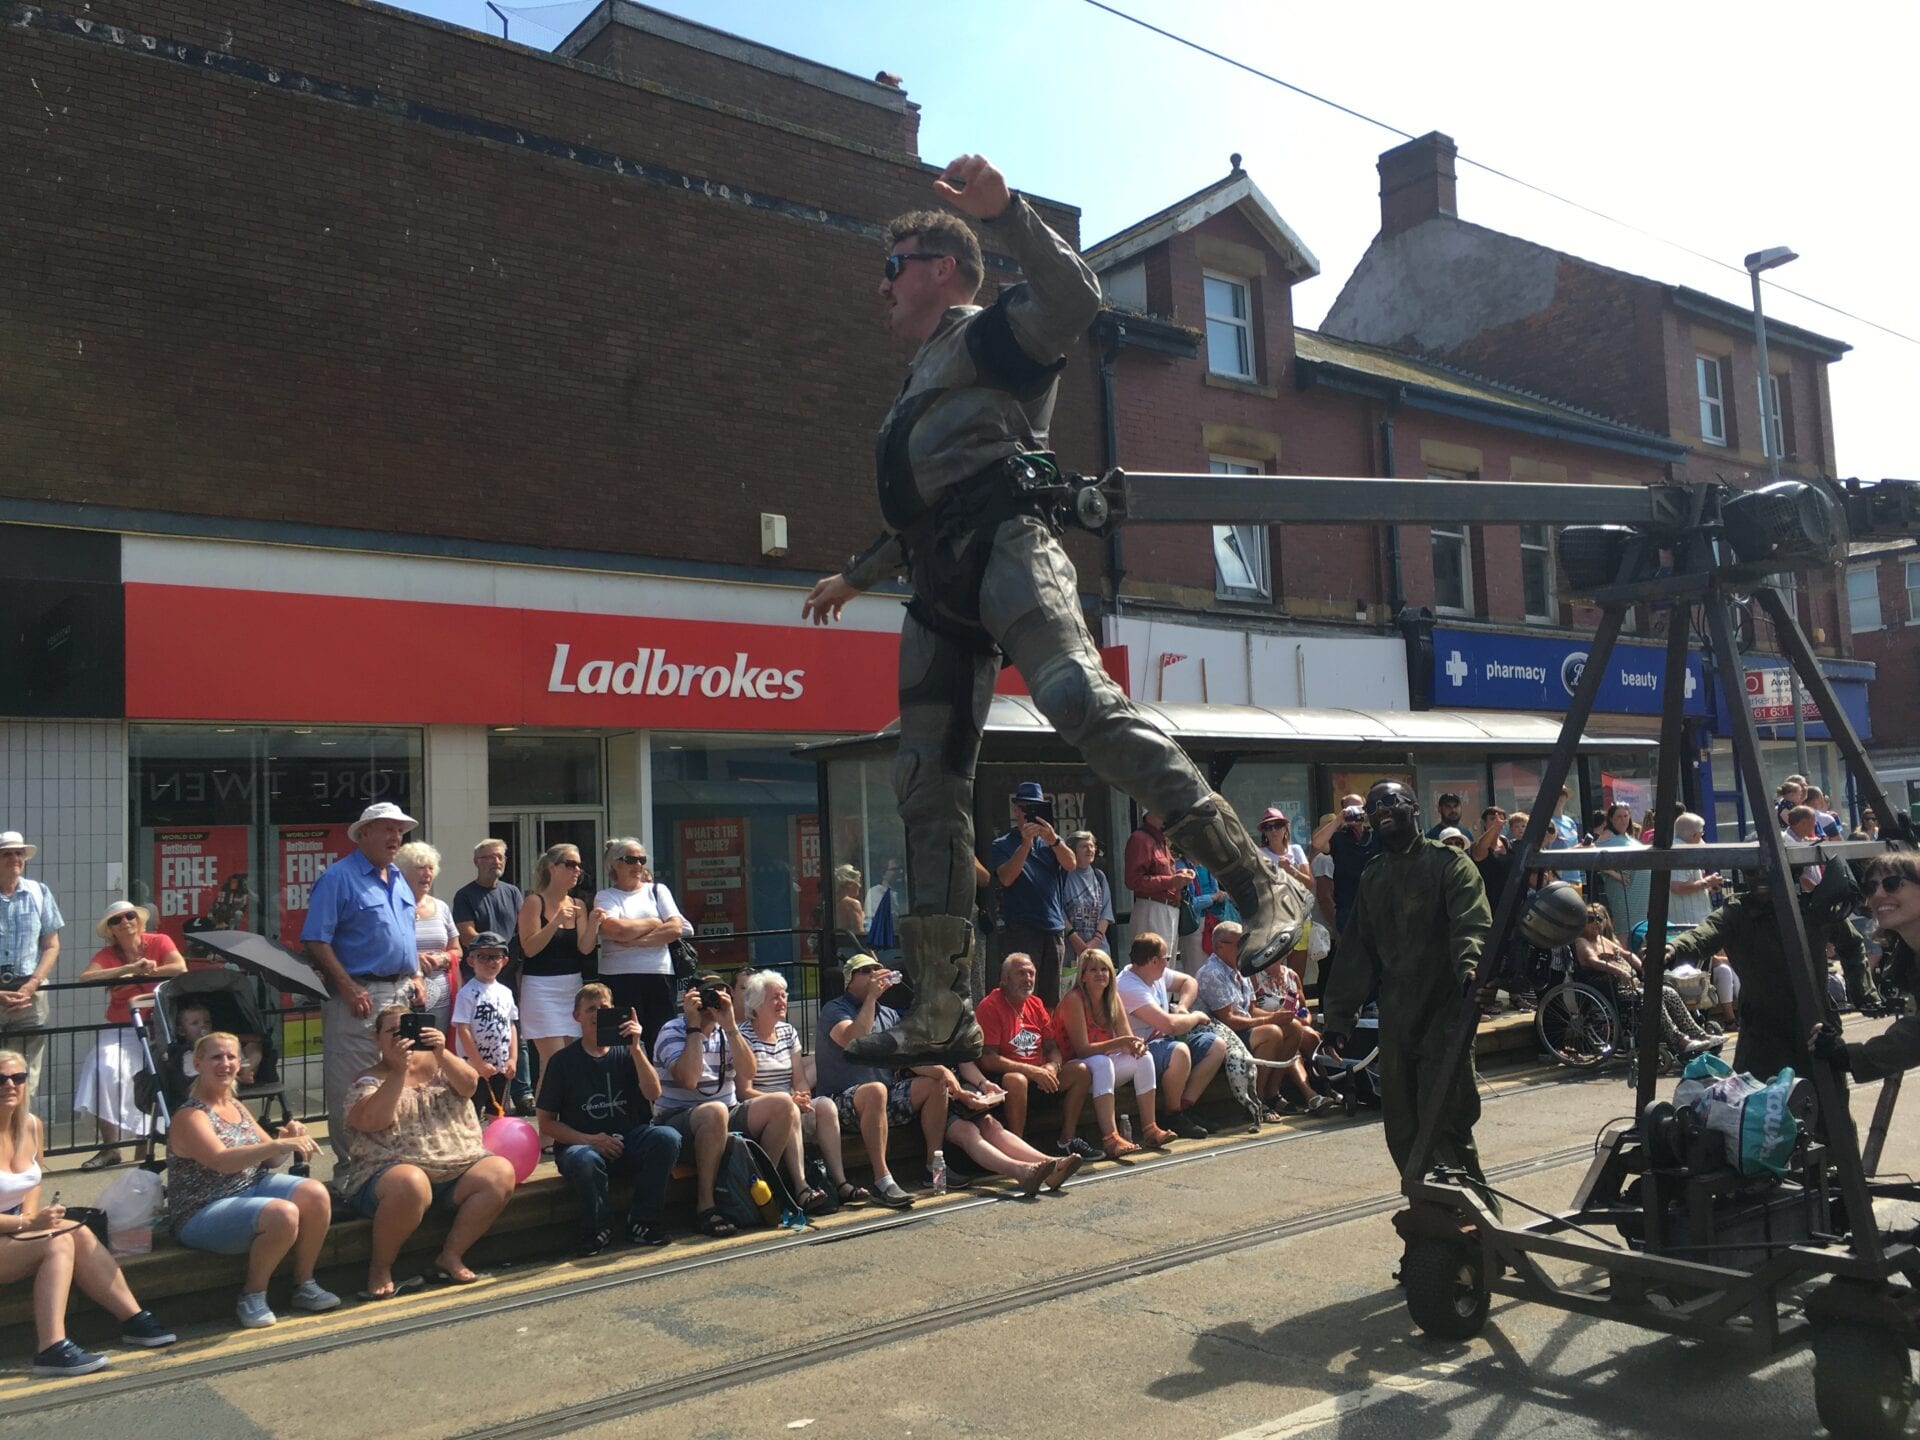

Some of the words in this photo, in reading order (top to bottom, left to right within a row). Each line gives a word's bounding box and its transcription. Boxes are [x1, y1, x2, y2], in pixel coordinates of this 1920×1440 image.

[548, 643, 805, 700] Ladbrokes
[1486, 660, 1546, 684] pharmacy
[1621, 669, 1658, 690] beauty
[161, 833, 188, 841] WORLD
[685, 826, 720, 840] WHAT'S
[722, 825, 738, 838] THE
[694, 839, 729, 852] SCORE?
[161, 856, 218, 888] FREE
[161, 888, 200, 917] BET
[287, 884, 311, 911] BE
